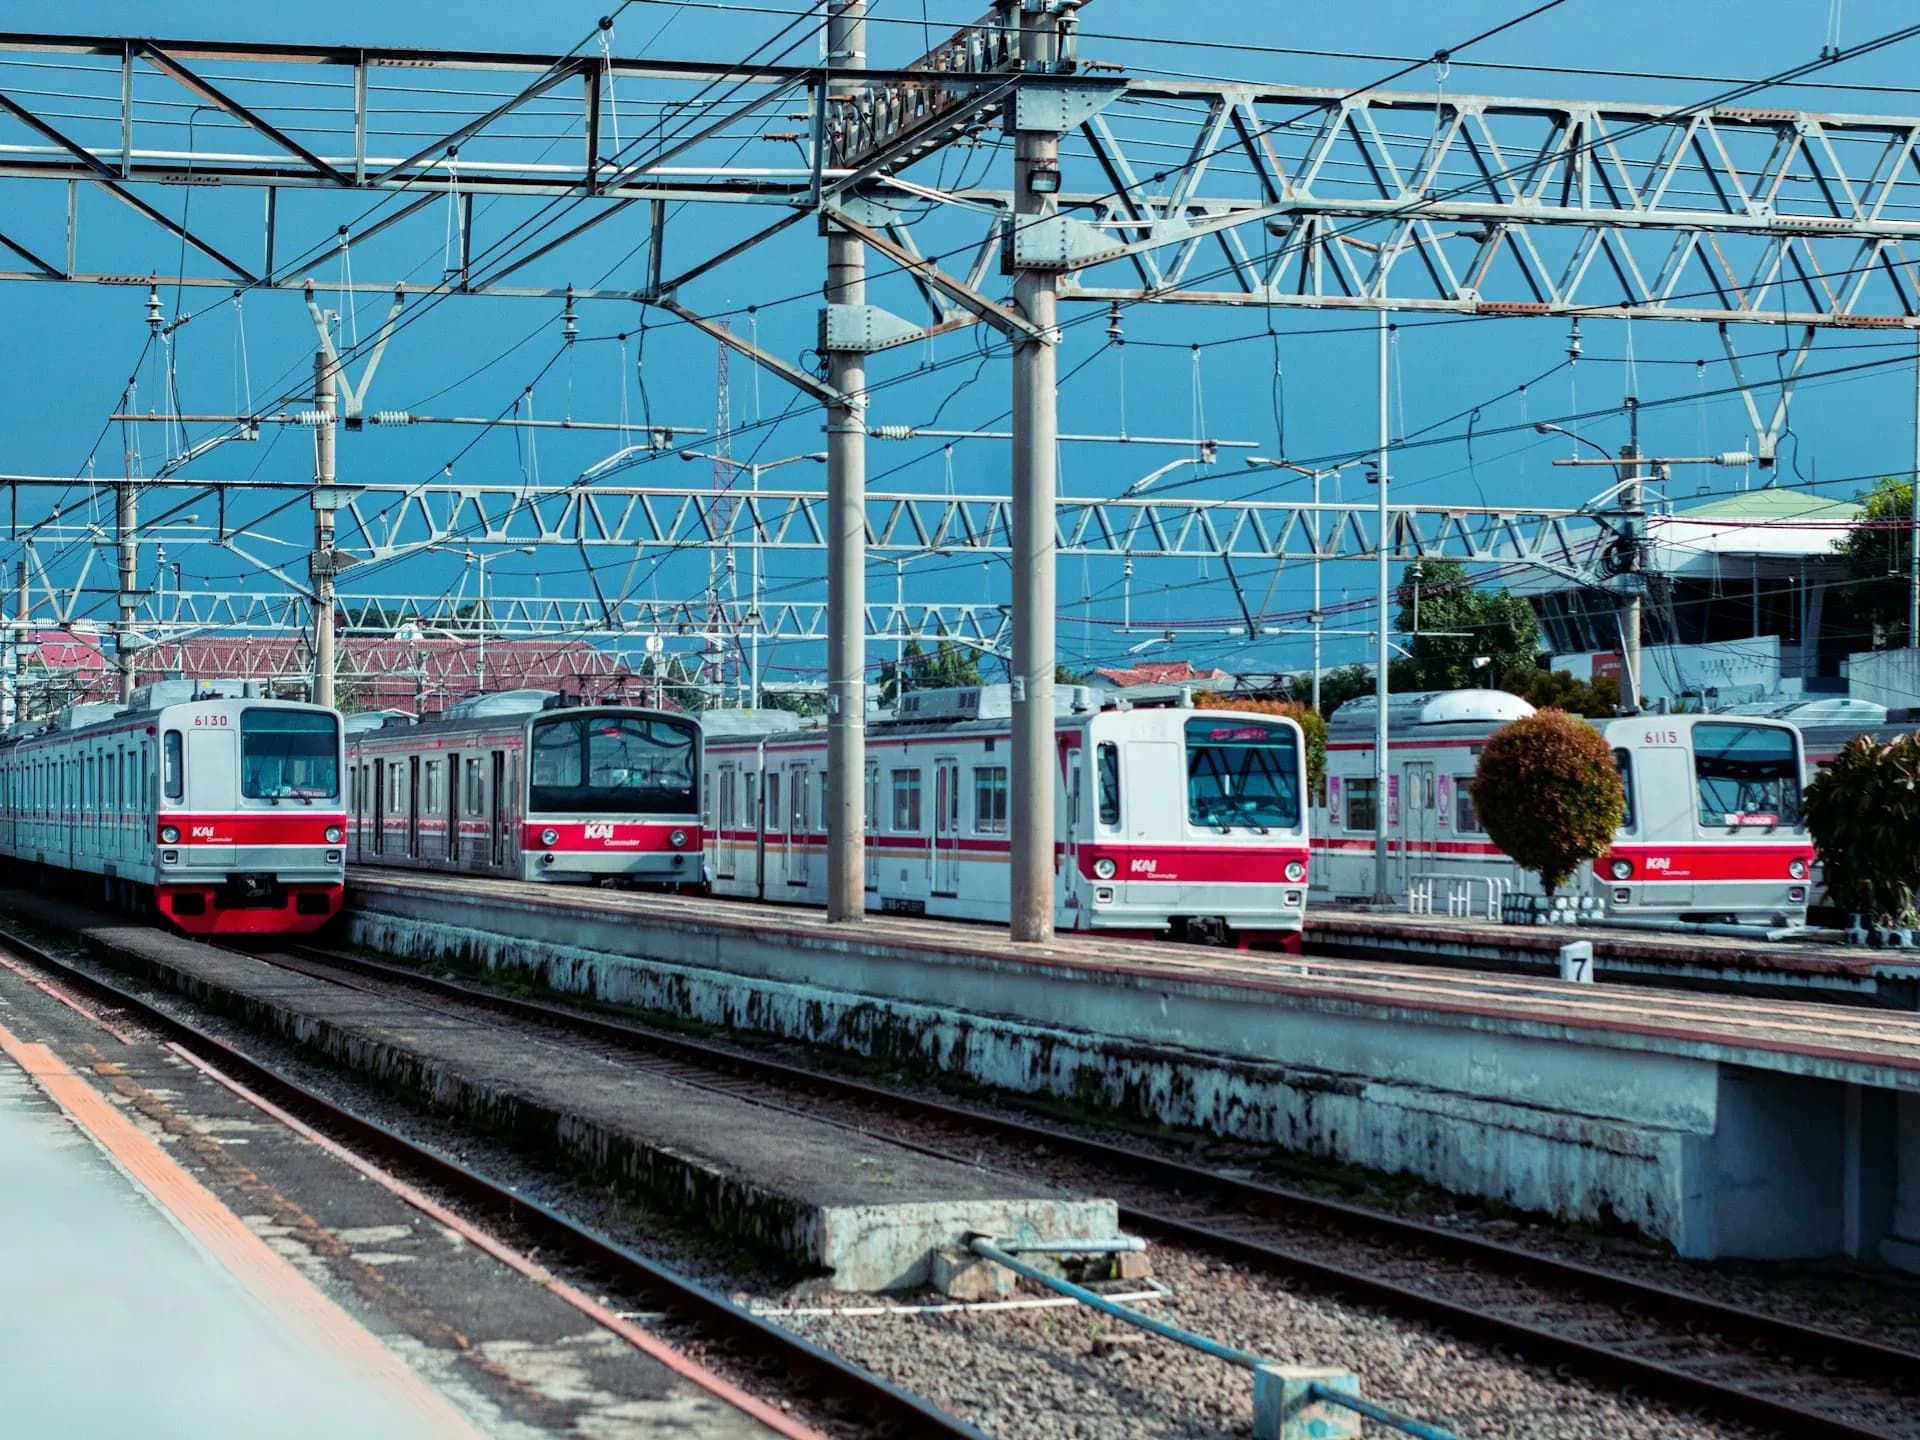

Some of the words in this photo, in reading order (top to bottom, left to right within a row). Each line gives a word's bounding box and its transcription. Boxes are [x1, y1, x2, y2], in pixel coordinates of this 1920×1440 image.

[194, 715, 228, 726] 6130
[1645, 731, 1677, 743] 6115
[192, 826, 214, 837] KAI
[584, 823, 614, 839] KAI
[1131, 859, 1157, 872] KAI
[1645, 857, 1671, 870] KAI
[1571, 957, 1587, 981] 7
